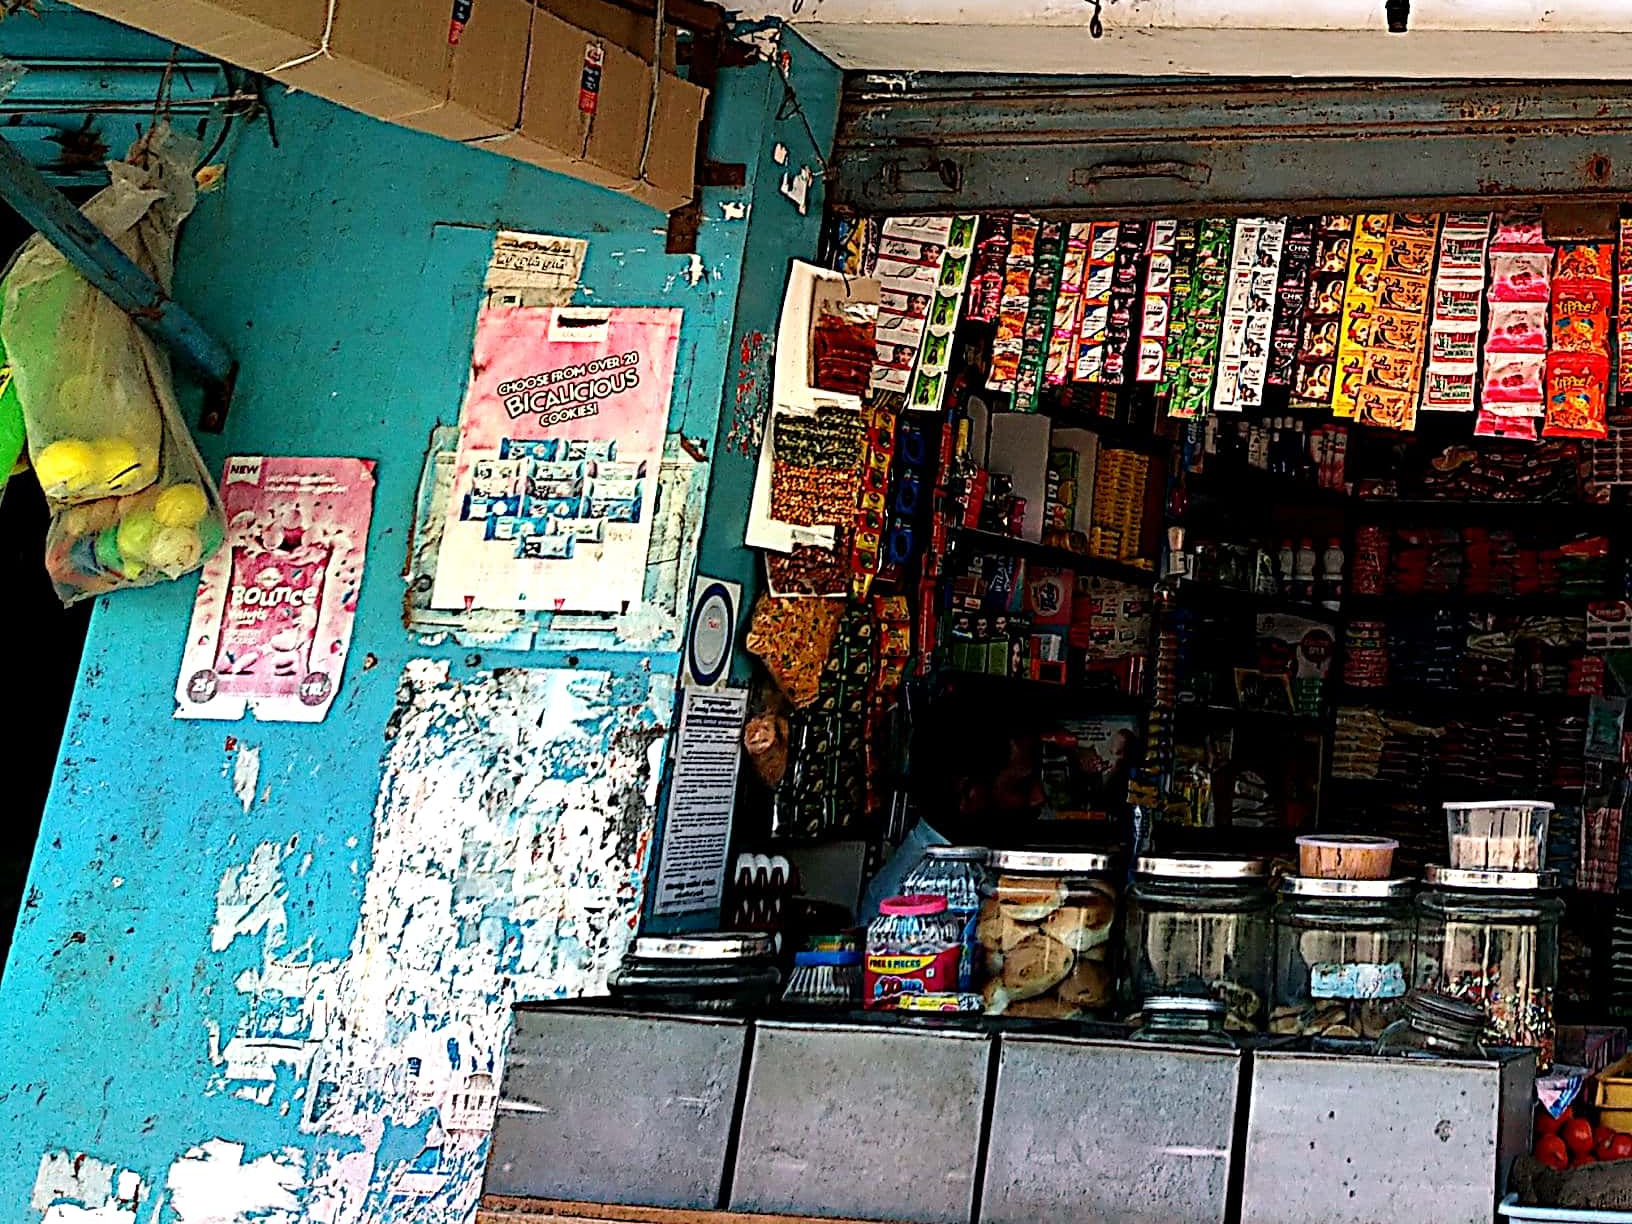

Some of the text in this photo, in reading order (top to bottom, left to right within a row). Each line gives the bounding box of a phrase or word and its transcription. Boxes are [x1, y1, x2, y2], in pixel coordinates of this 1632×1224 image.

[498, 351, 639, 396] CHOOSE FROM OVER 20
[504, 368, 639, 419] BICALICIOUS
[230, 464, 260, 474] NEW
